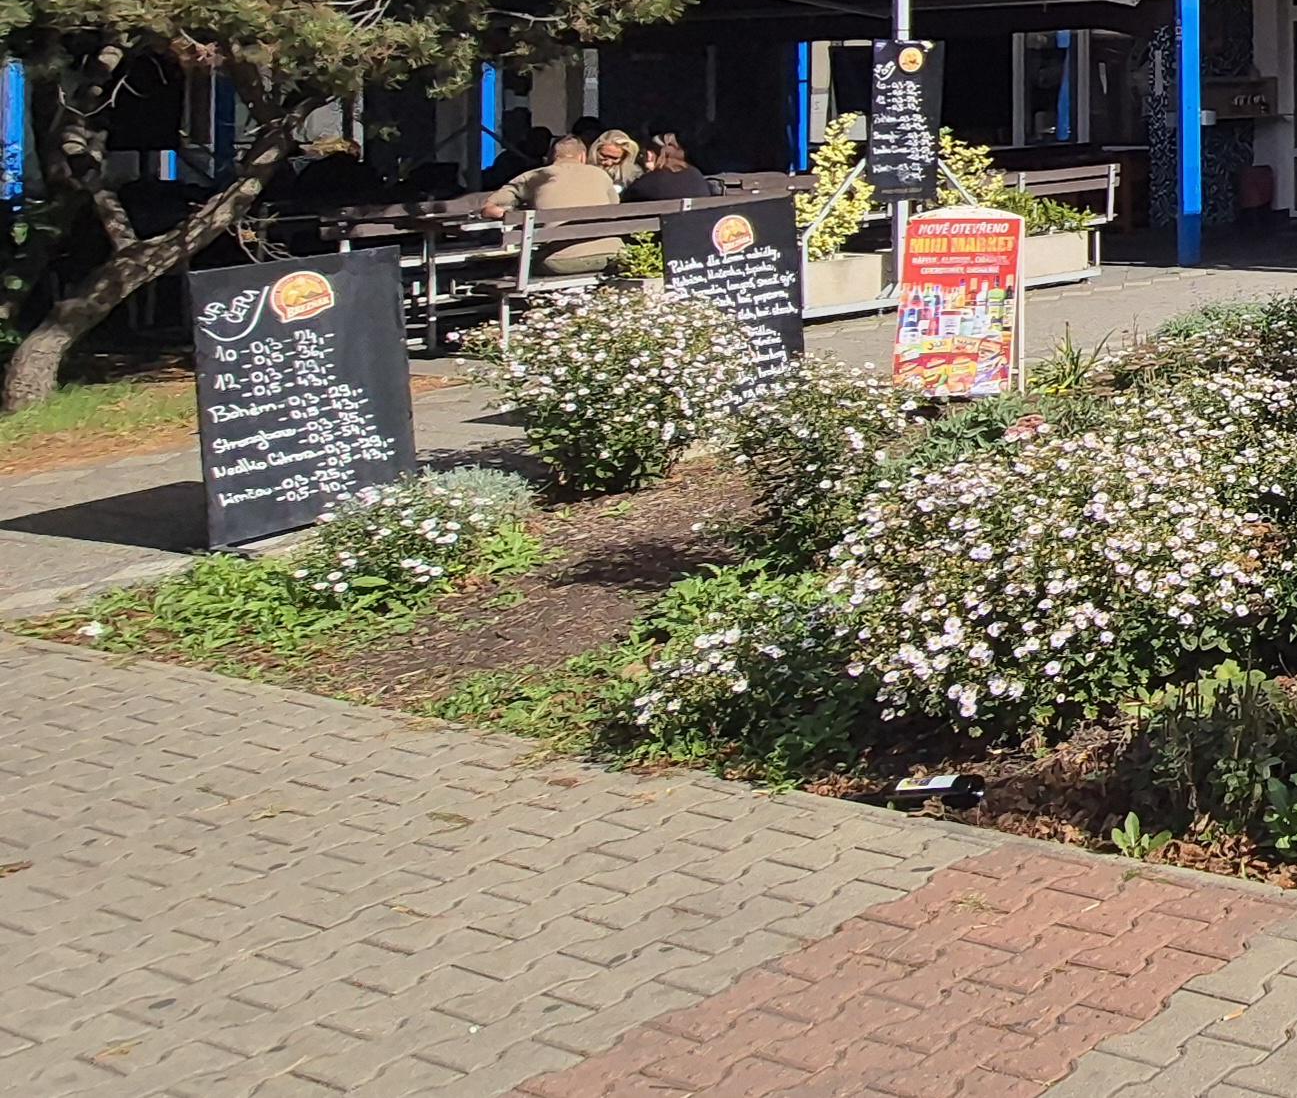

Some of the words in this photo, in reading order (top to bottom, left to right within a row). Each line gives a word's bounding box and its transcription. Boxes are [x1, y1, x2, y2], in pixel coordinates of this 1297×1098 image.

[918, 222, 950, 234] NOVÉ
[951, 222, 1010, 234] OTEVŘENO
[215, 345, 237, 362] 10
[214, 373, 241, 391] 12
